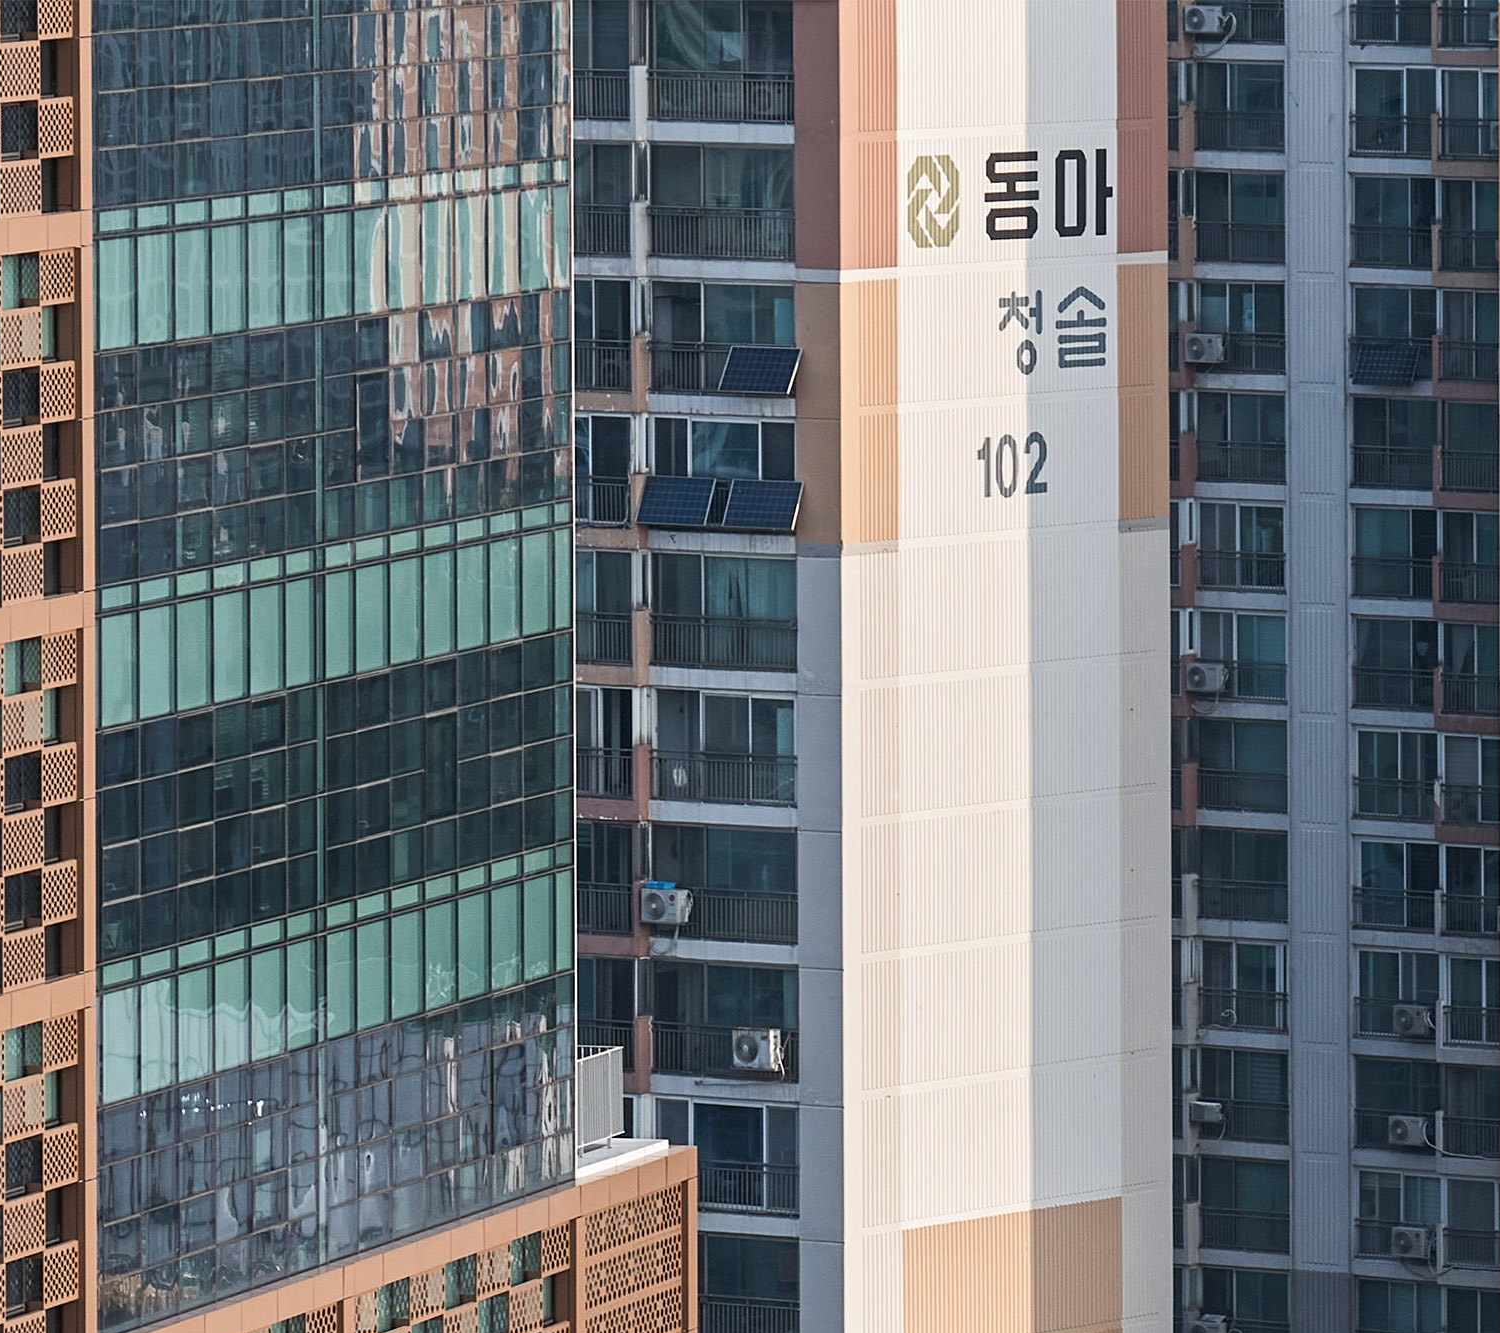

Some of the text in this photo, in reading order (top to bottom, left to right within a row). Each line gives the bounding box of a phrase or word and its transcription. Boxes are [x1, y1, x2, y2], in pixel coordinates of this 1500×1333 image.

[984, 147, 1114, 241] 동아
[997, 285, 1108, 375] 청솔
[977, 431, 1049, 499] 102
